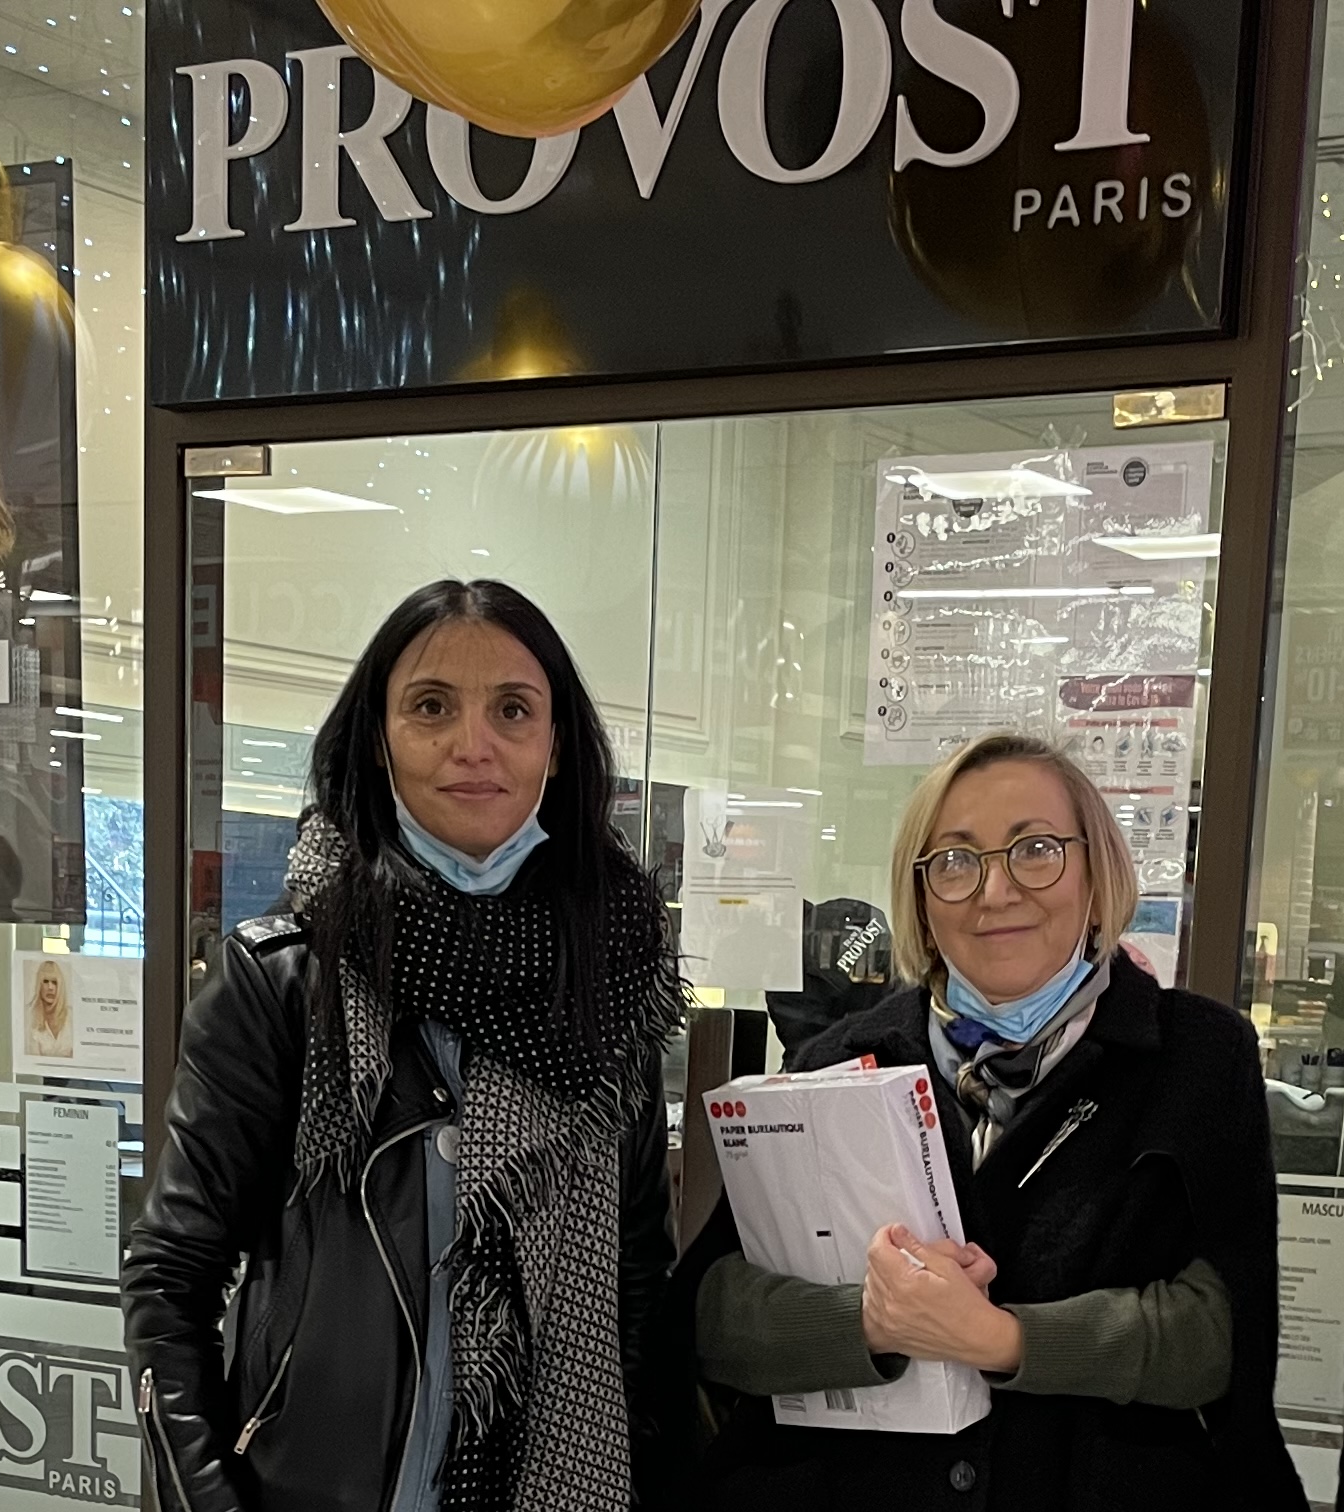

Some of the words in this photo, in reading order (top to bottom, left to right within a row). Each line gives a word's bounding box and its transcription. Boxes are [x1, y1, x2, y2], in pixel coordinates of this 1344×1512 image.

[1010, 172, 1194, 234] PARIS
[836, 917, 886, 974] PROVOST
[48, 1469, 117, 1500] PARIS
